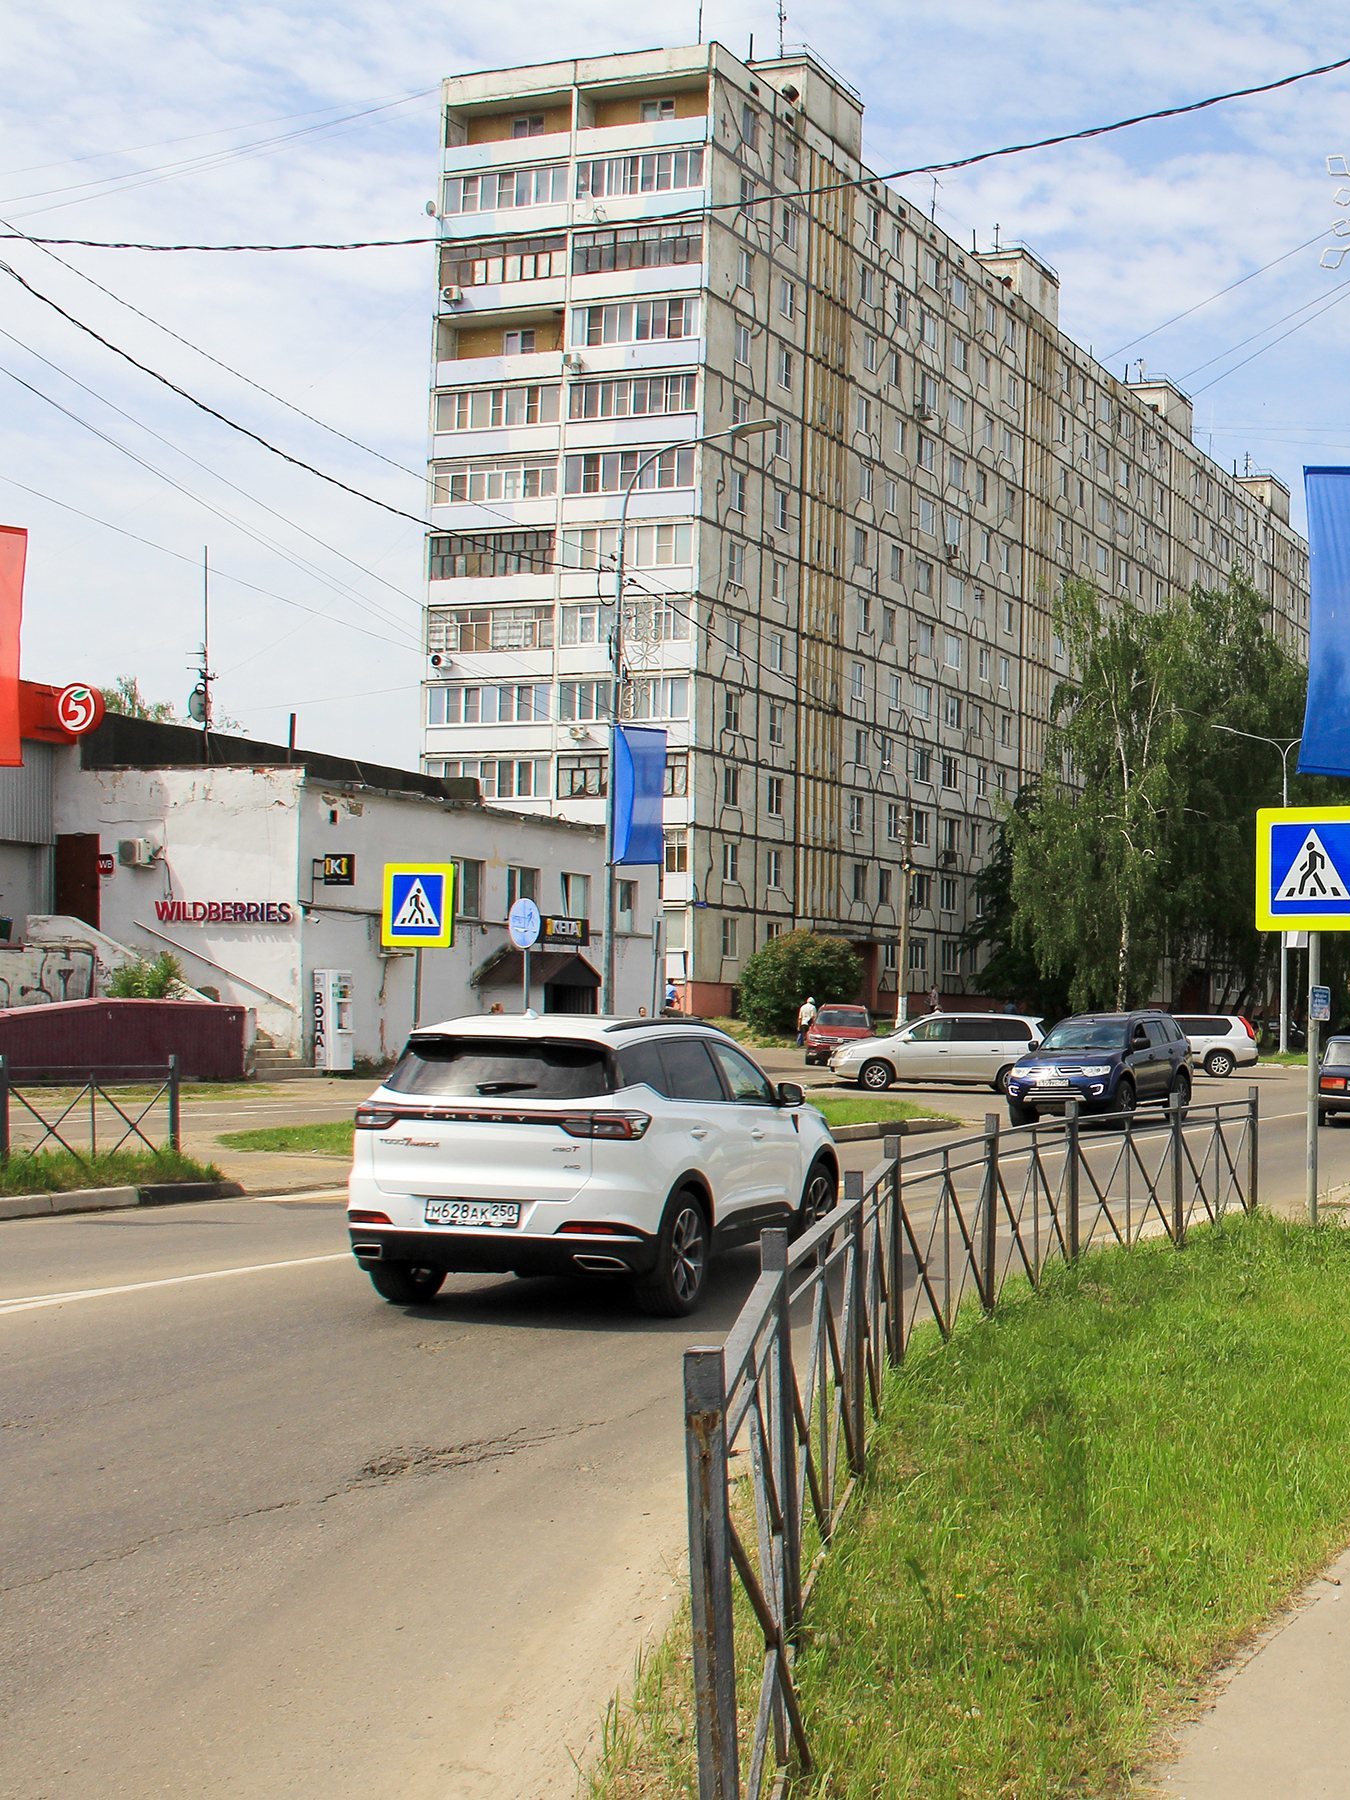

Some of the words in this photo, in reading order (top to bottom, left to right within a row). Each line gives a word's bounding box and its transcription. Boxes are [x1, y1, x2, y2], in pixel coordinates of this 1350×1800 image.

[98, 859, 113, 869] WB
[154, 900, 294, 923] WILDBERRIES
[314, 991, 325, 1048] ВОДА
[423, 1112, 526, 1122] CHERY
[431, 1202, 489, 1220] М628АК
[491, 1204, 515, 1217] 250
